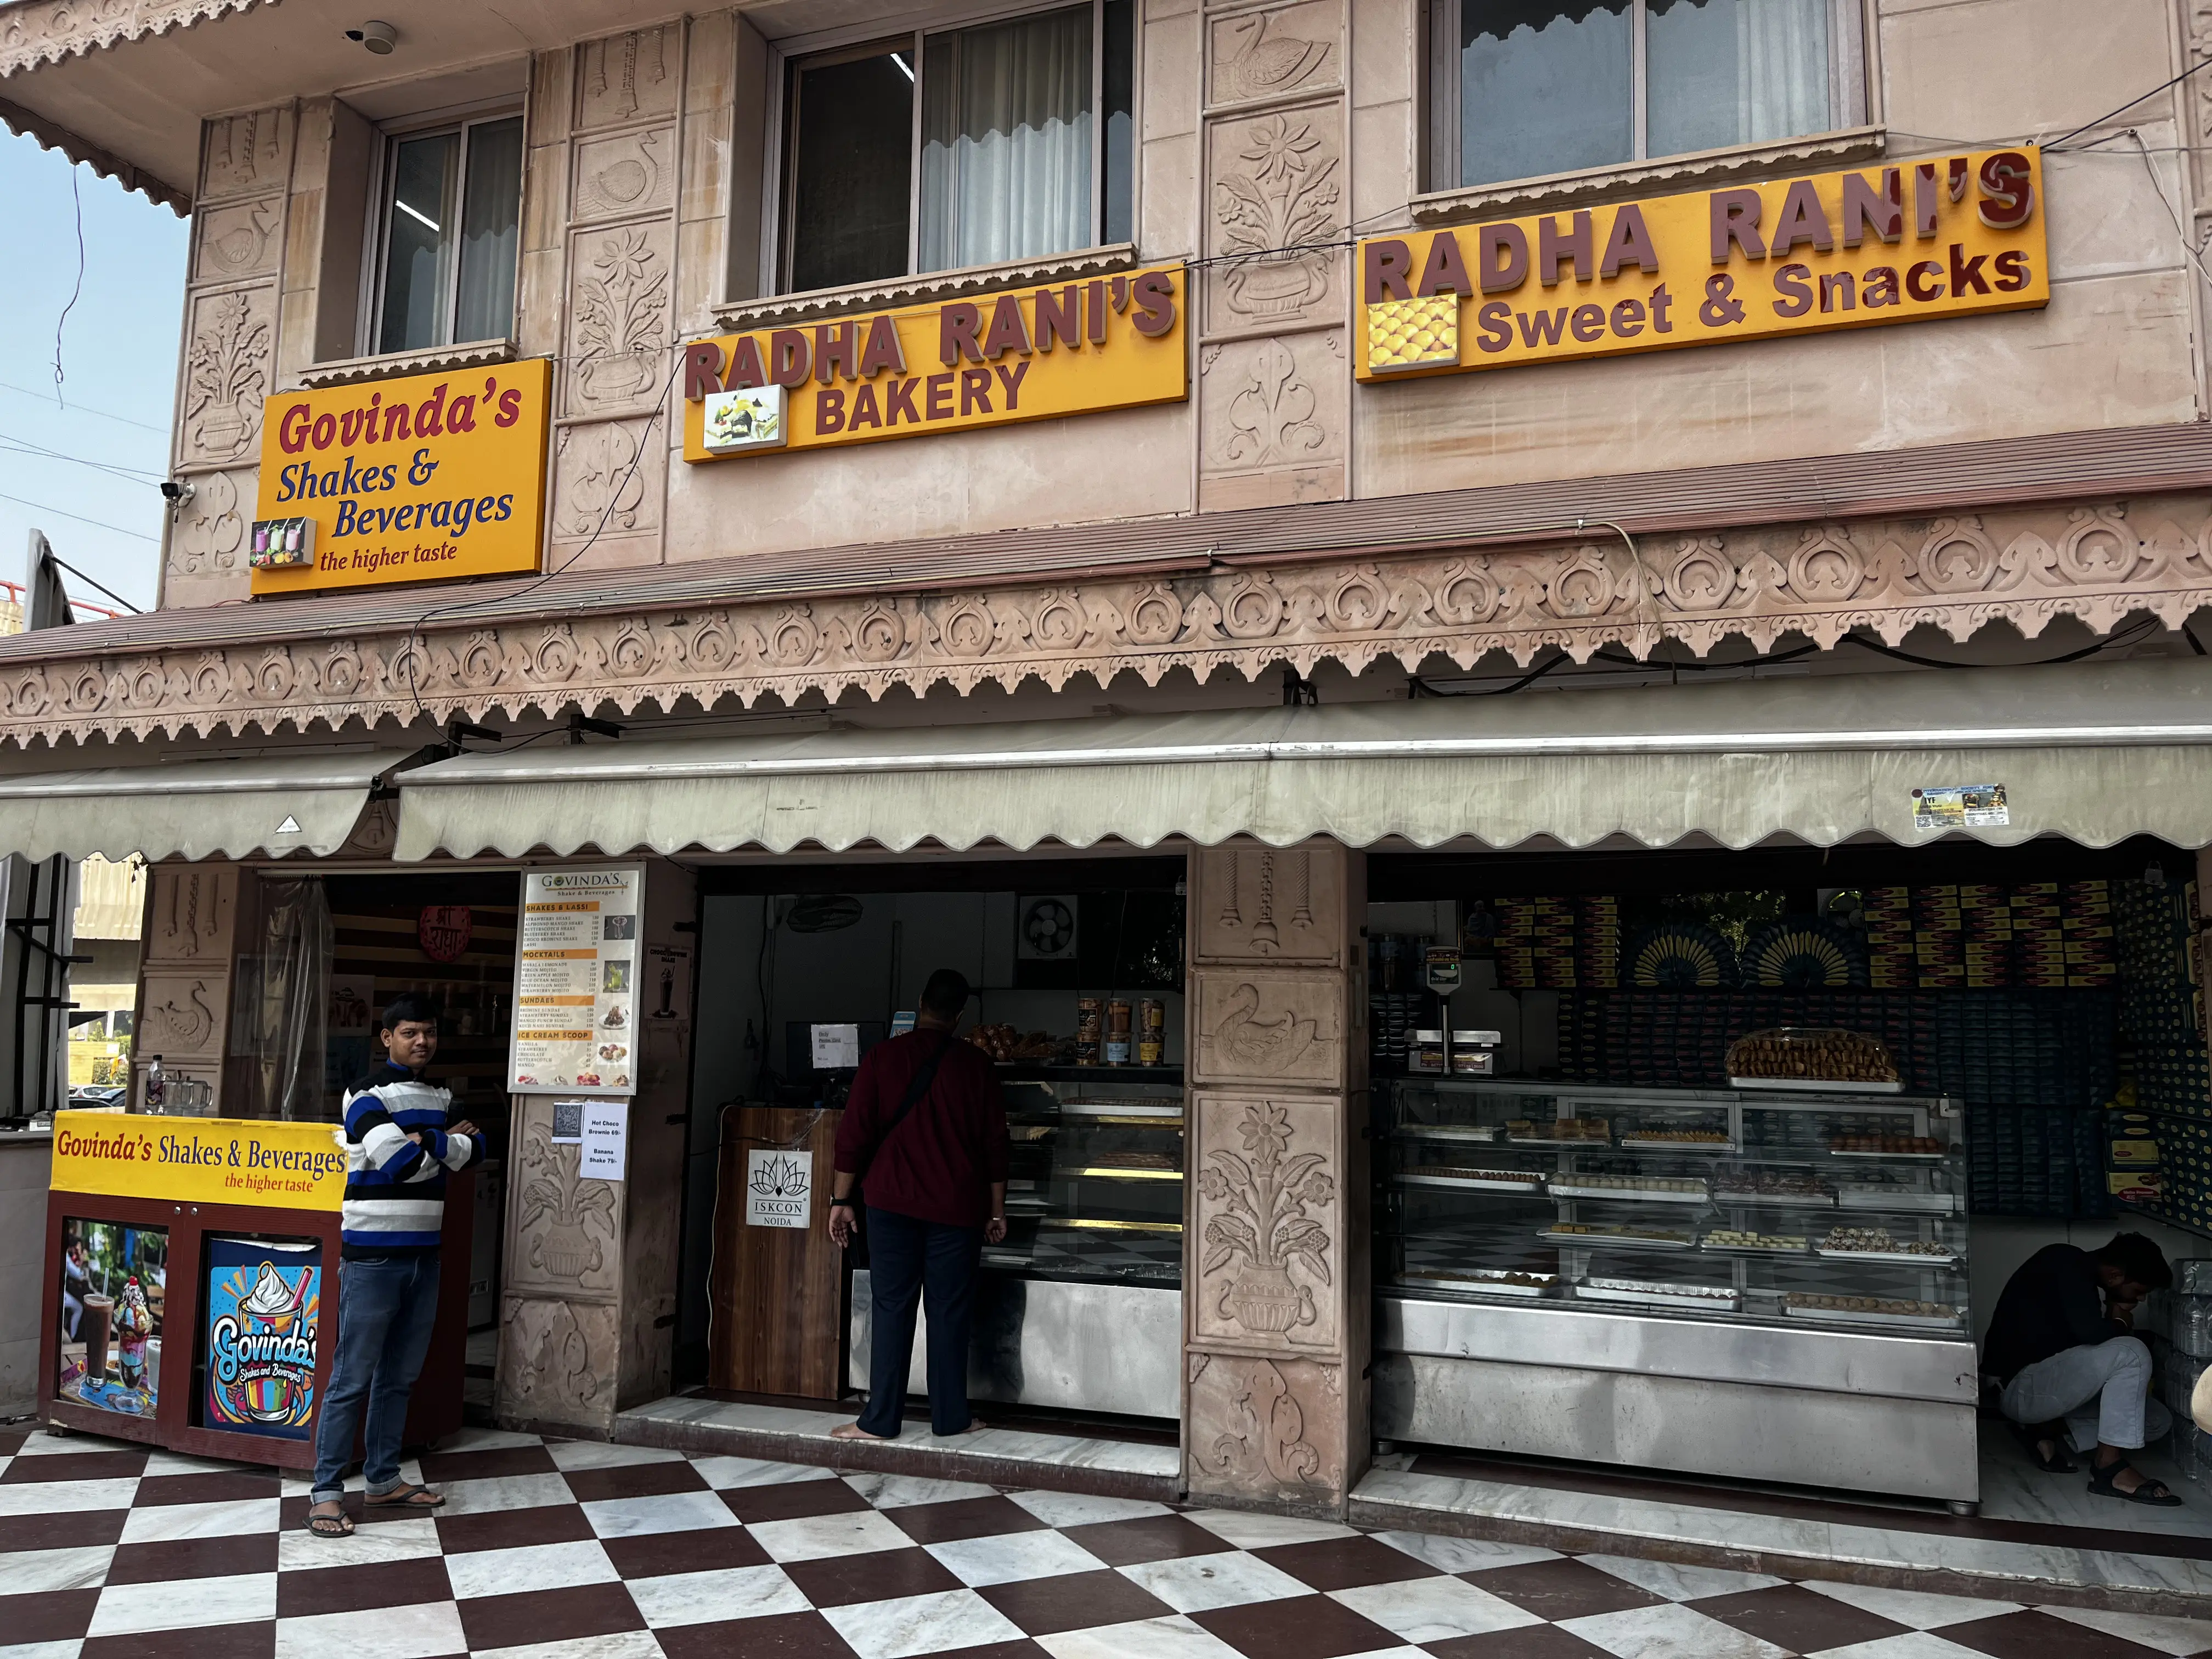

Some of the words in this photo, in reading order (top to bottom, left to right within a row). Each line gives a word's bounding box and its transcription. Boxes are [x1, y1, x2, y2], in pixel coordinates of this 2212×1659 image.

[1364, 204, 1660, 305] RADHA
[1710, 151, 2034, 266] RANI'S
[1476, 282, 1673, 353] Sweet
[1699, 273, 1746, 328] &
[1773, 243, 2032, 319] Snacks
[685, 315, 907, 402] RADHA
[940, 272, 1176, 366] RANI'S
[279, 376, 522, 455] Govinda's
[815, 360, 1030, 436] BAKERY
[276, 455, 397, 503] Shakes
[408, 448, 439, 486] &
[332, 493, 514, 538] Beverages
[320, 551, 348, 572] the
[352, 544, 409, 573] higher
[414, 541, 458, 562] taste
[430, 927, 462, 952] राधा
[58, 1130, 153, 1161] Govinda's
[159, 1135, 223, 1166] Shakes
[227, 1139, 241, 1167] &
[247, 1140, 345, 1181] Beverages
[225, 1173, 244, 1188] the
[246, 1173, 283, 1193] higher
[285, 1177, 313, 1193] taste
[755, 1202, 802, 1213] ISKCON
[764, 1217, 792, 1226] NOIDA
[240, 1368, 259, 1381] Shakes
[260, 1365, 270, 1375] and
[272, 1363, 301, 1383] Beverages
